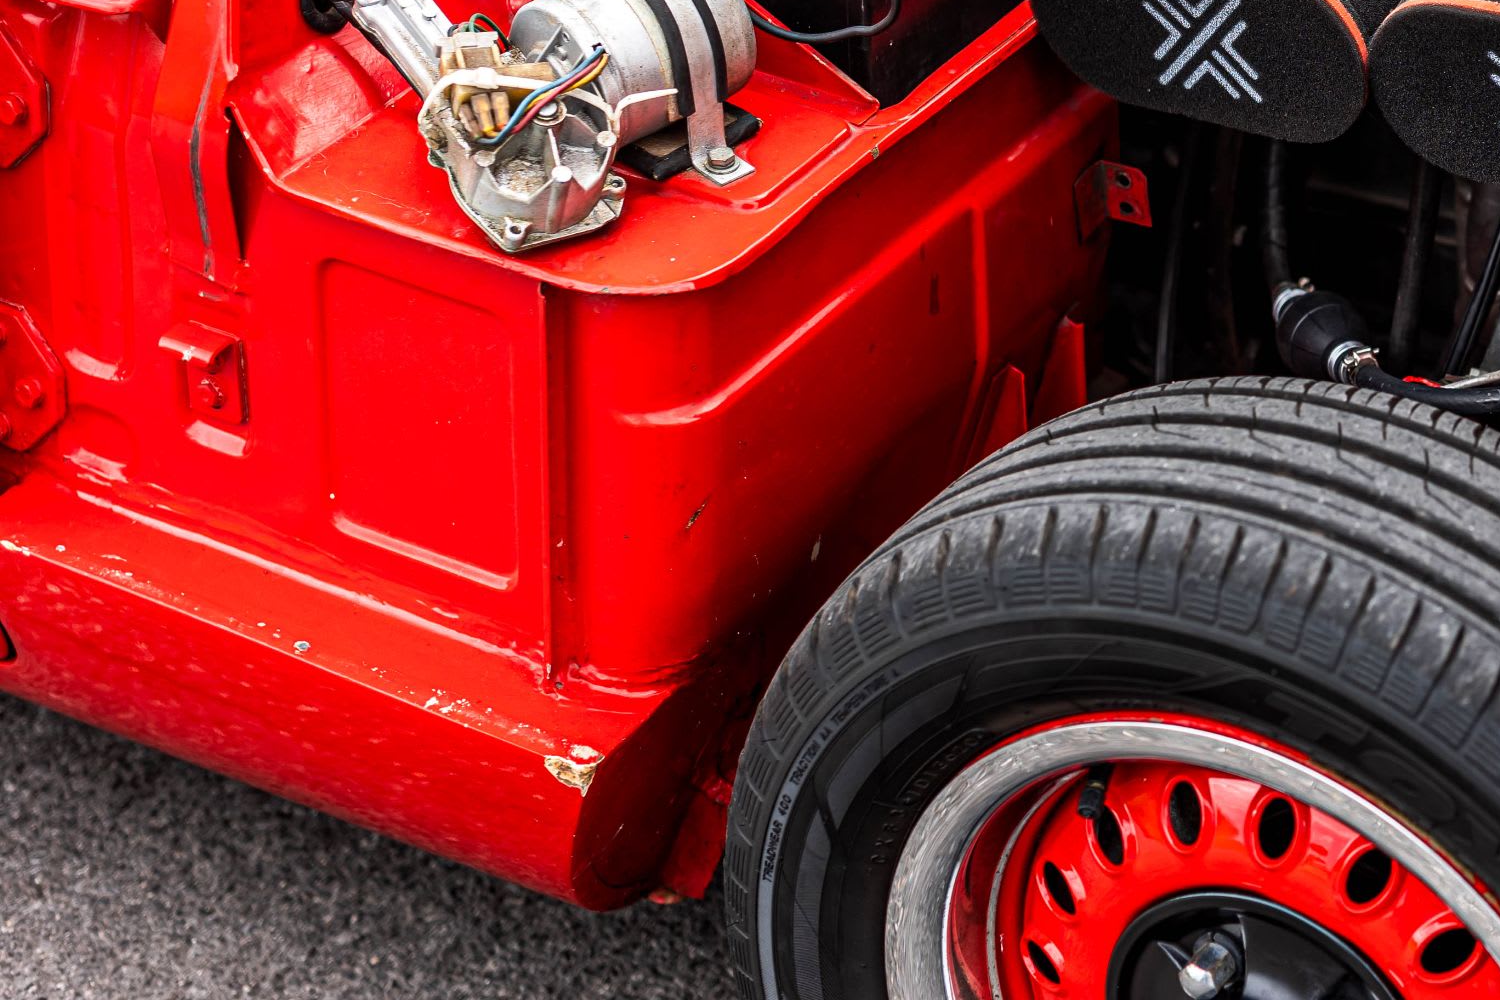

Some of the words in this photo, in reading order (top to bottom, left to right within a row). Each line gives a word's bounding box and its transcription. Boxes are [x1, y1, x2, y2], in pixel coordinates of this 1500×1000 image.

[763, 820, 782, 882] TREADWEAR
[779, 794, 792, 815] 400
[789, 743, 820, 785] TRACTION
[830, 674, 887, 727] TEMPERATURE
